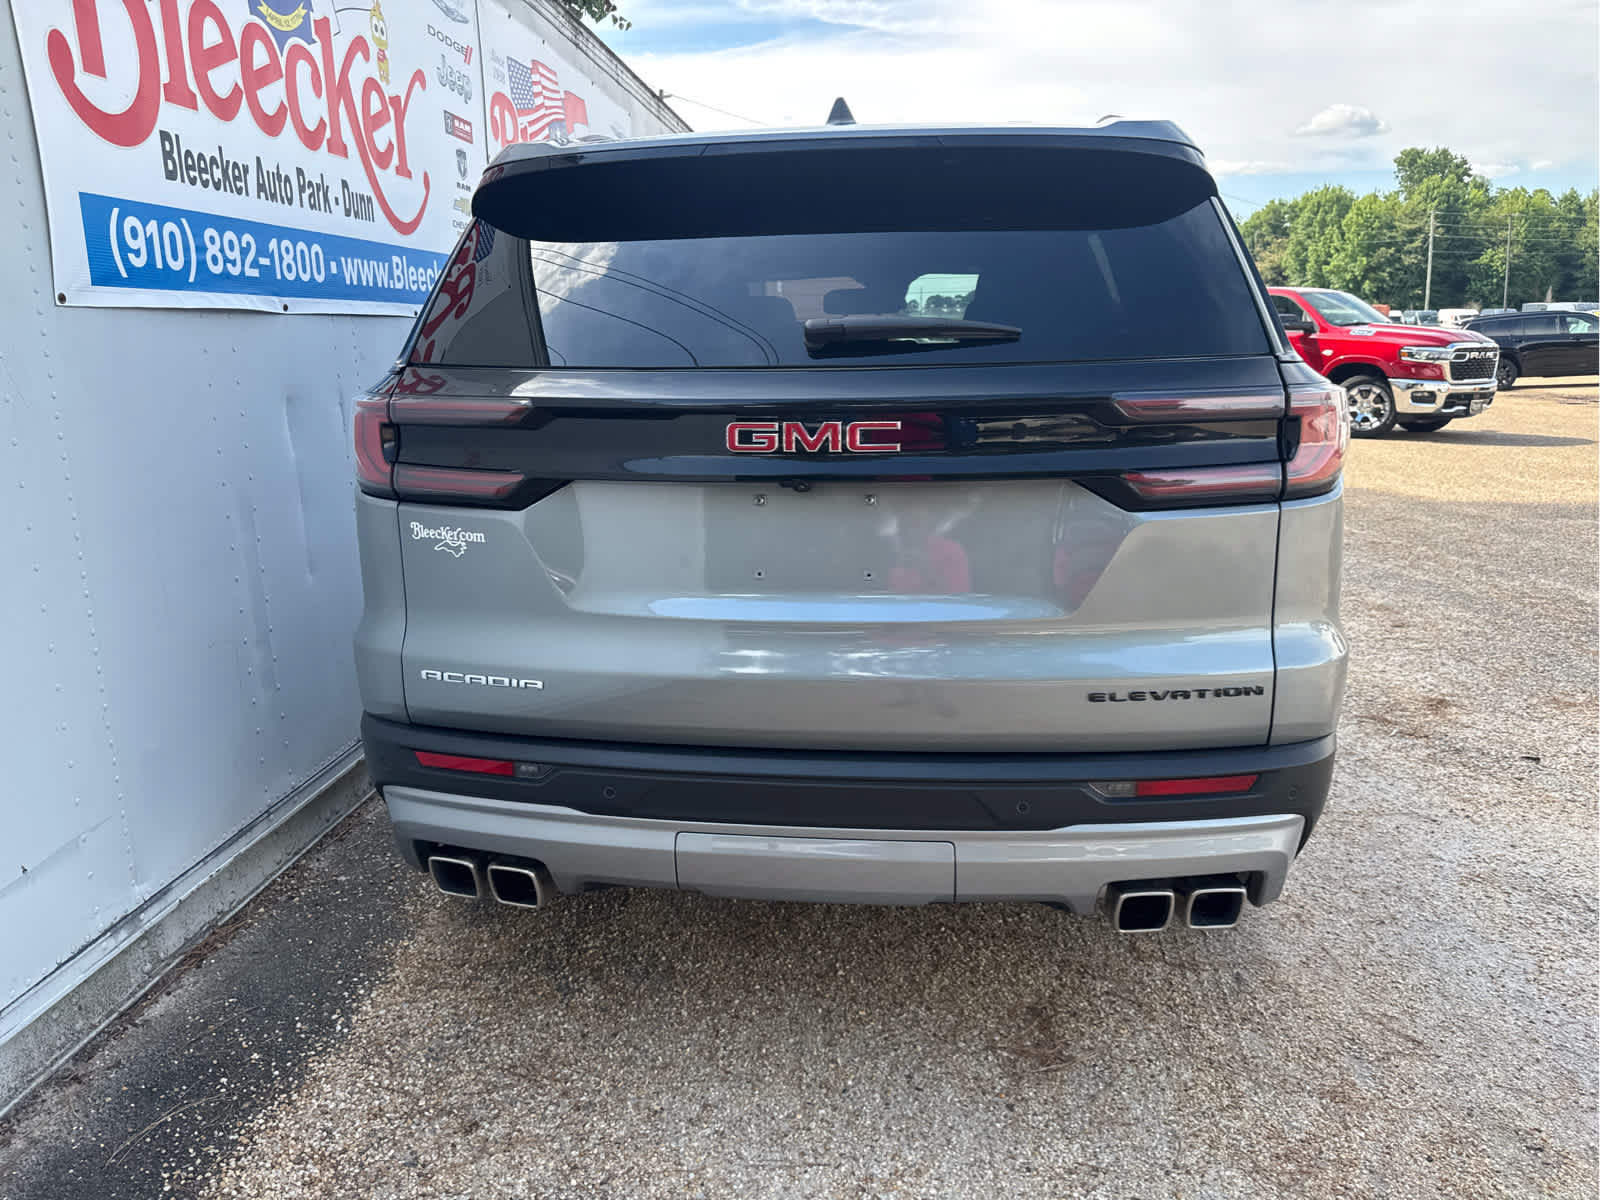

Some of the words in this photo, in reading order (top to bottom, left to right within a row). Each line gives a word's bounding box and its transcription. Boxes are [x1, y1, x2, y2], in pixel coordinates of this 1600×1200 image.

[427, 24, 467, 57] DODGE
[436, 53, 472, 105] Jeep
[159, 129, 249, 197] Bleecker
[255, 156, 294, 206] Auto
[295, 166, 332, 214] Park
[341, 178, 375, 223] Dunn
[456, 181, 471, 193] RAM
[109, 207, 197, 283] (910)
[205, 228, 325, 284] 892-1800
[1470, 351, 1498, 361] RAM
[726, 420, 901, 453] GMC
[420, 669, 545, 690] ACADIA
[1087, 685, 1264, 704] ELEVATION
